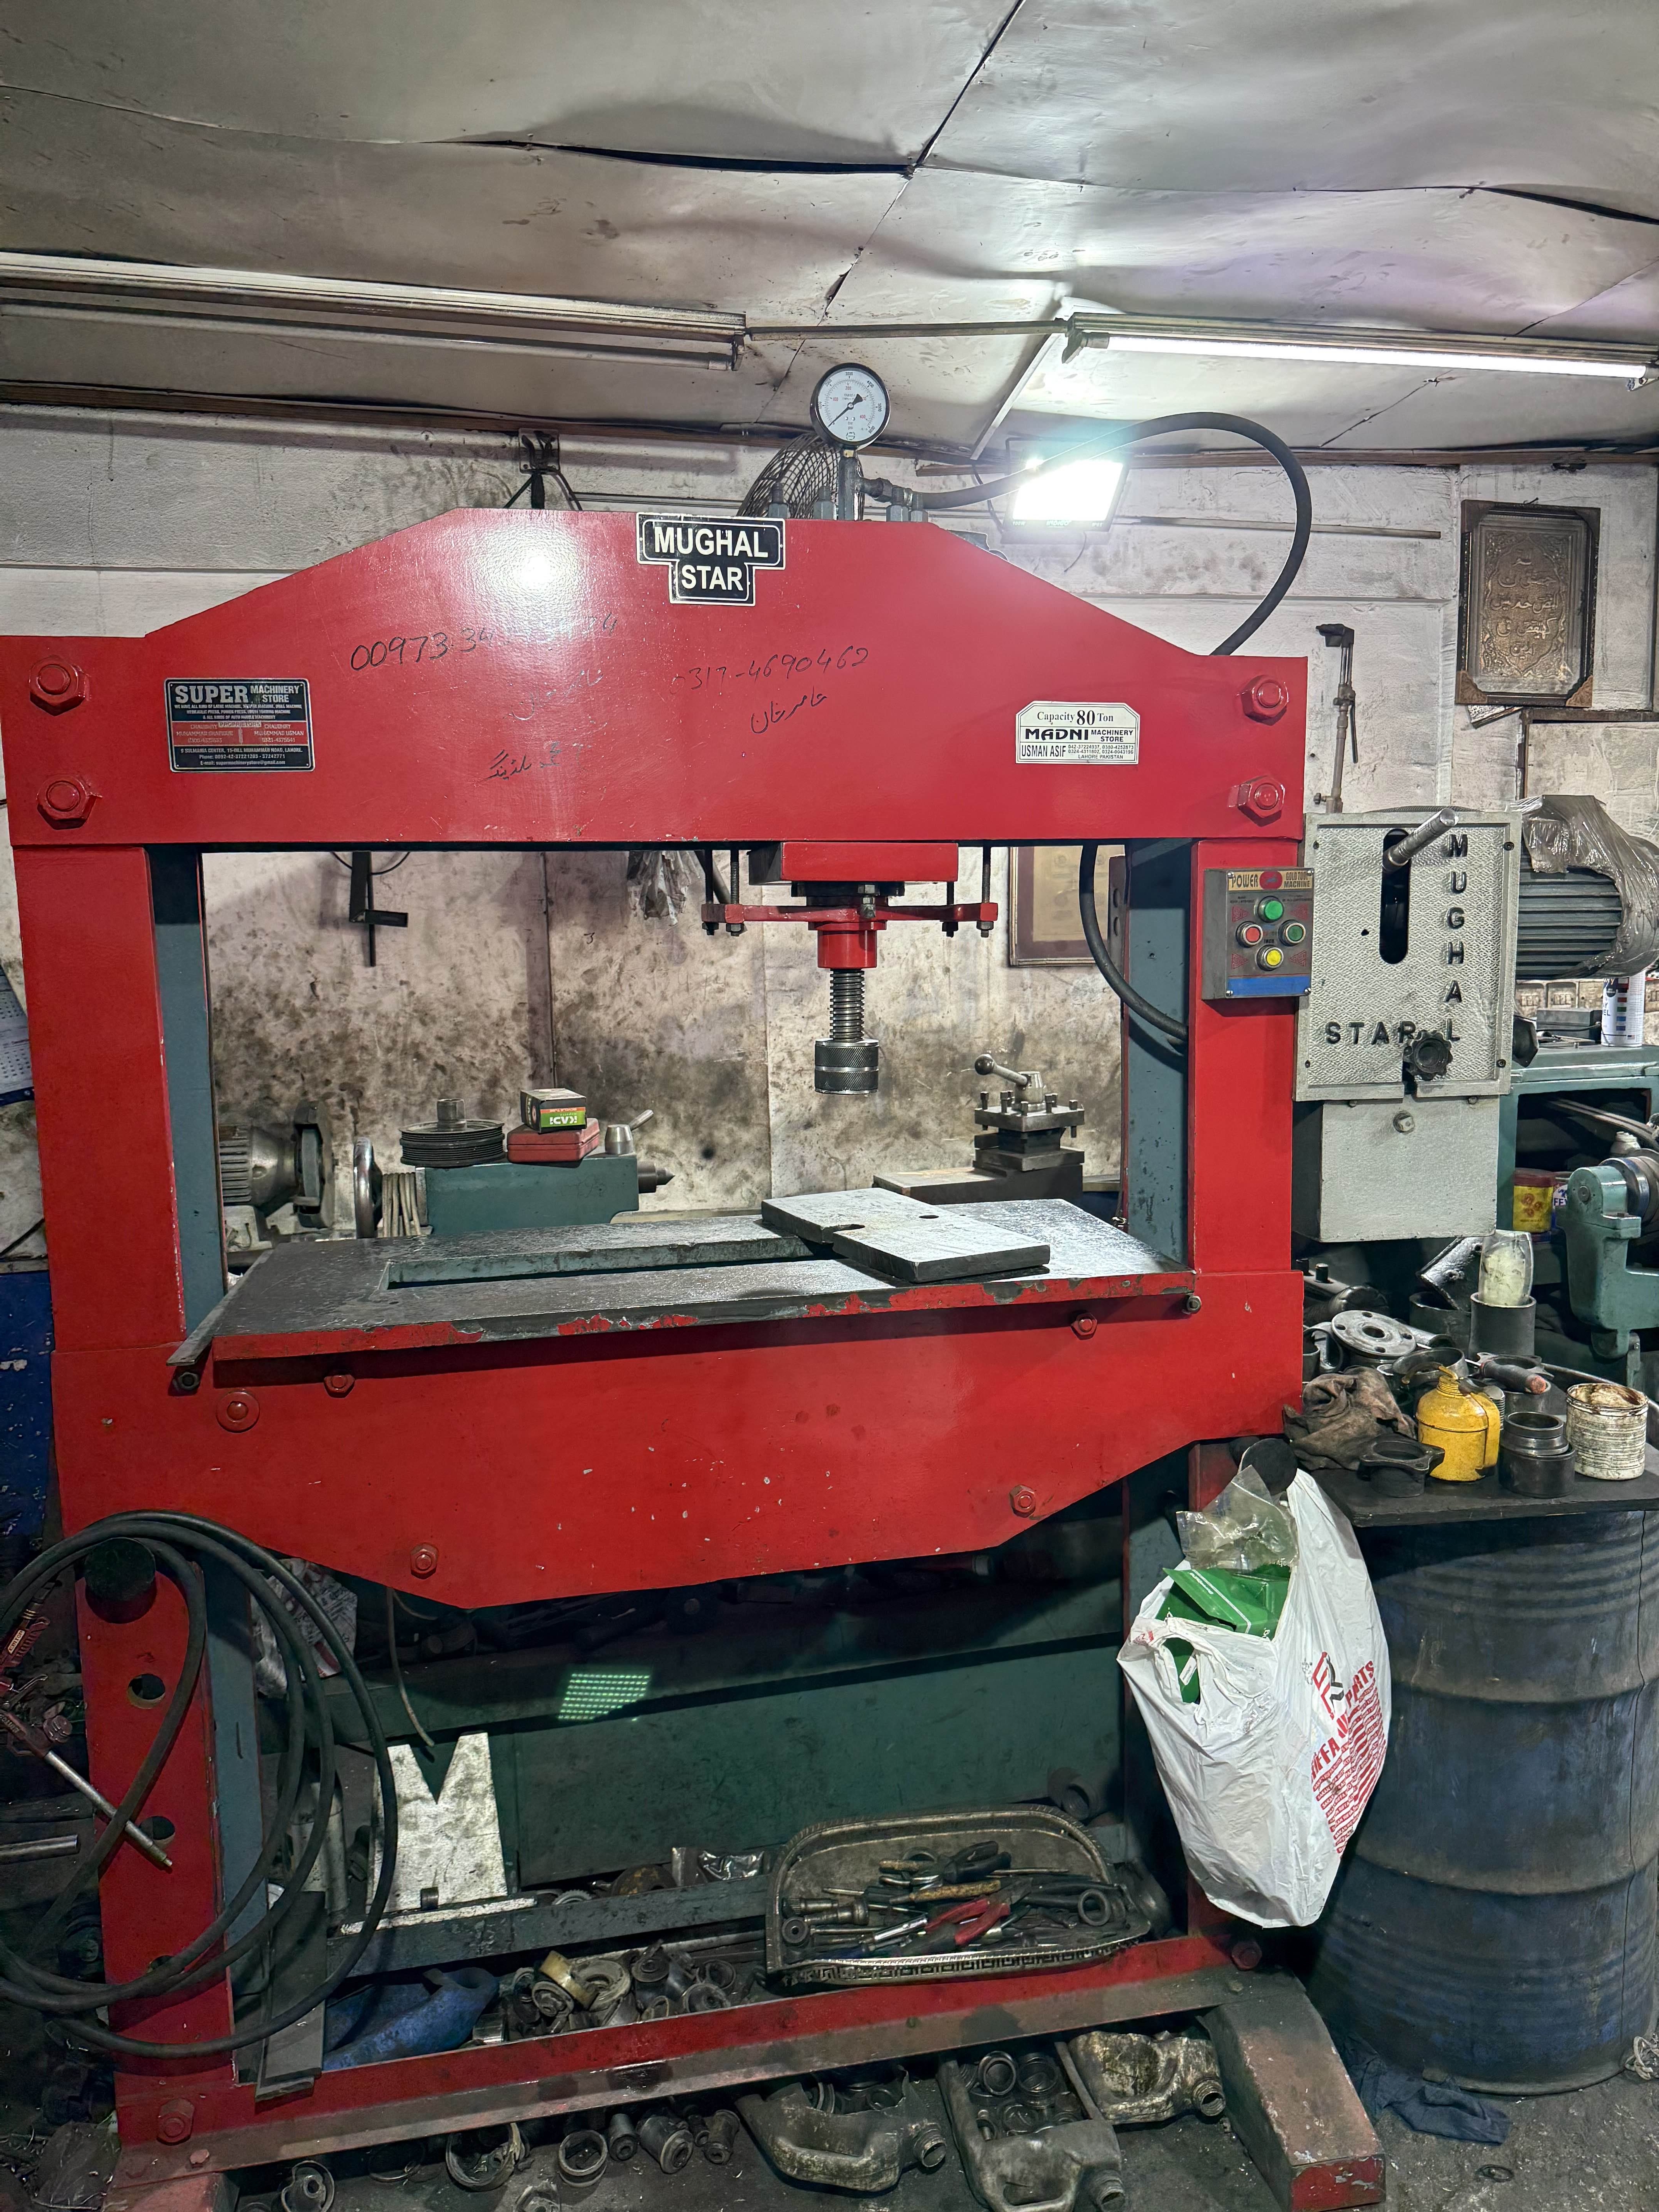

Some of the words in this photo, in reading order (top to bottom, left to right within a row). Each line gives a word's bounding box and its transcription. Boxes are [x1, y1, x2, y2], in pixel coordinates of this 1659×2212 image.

[654, 526, 768, 558] MUGHAL
[681, 564, 744, 591] STAR
[175, 685, 249, 704] SUPER
[250, 685, 300, 694] MACHINERY
[262, 694, 289, 703] STORE
[1037, 711, 1075, 723] Capacity
[1076, 710, 1095, 725] 80
[1097, 713, 1114, 722] Ton
[1025, 728, 1089, 741] MADNI
[1022, 745, 1048, 757] USMAN
[1050, 745, 1066, 757] ASIF
[1231, 874, 1258, 888] POWER
[1286, 872, 1297, 881] GOLD
[1284, 880, 1310, 888] MACHINE
[1443, 833, 1468, 1042] MUGHAL
[1324, 1021, 1416, 1045] STAR
